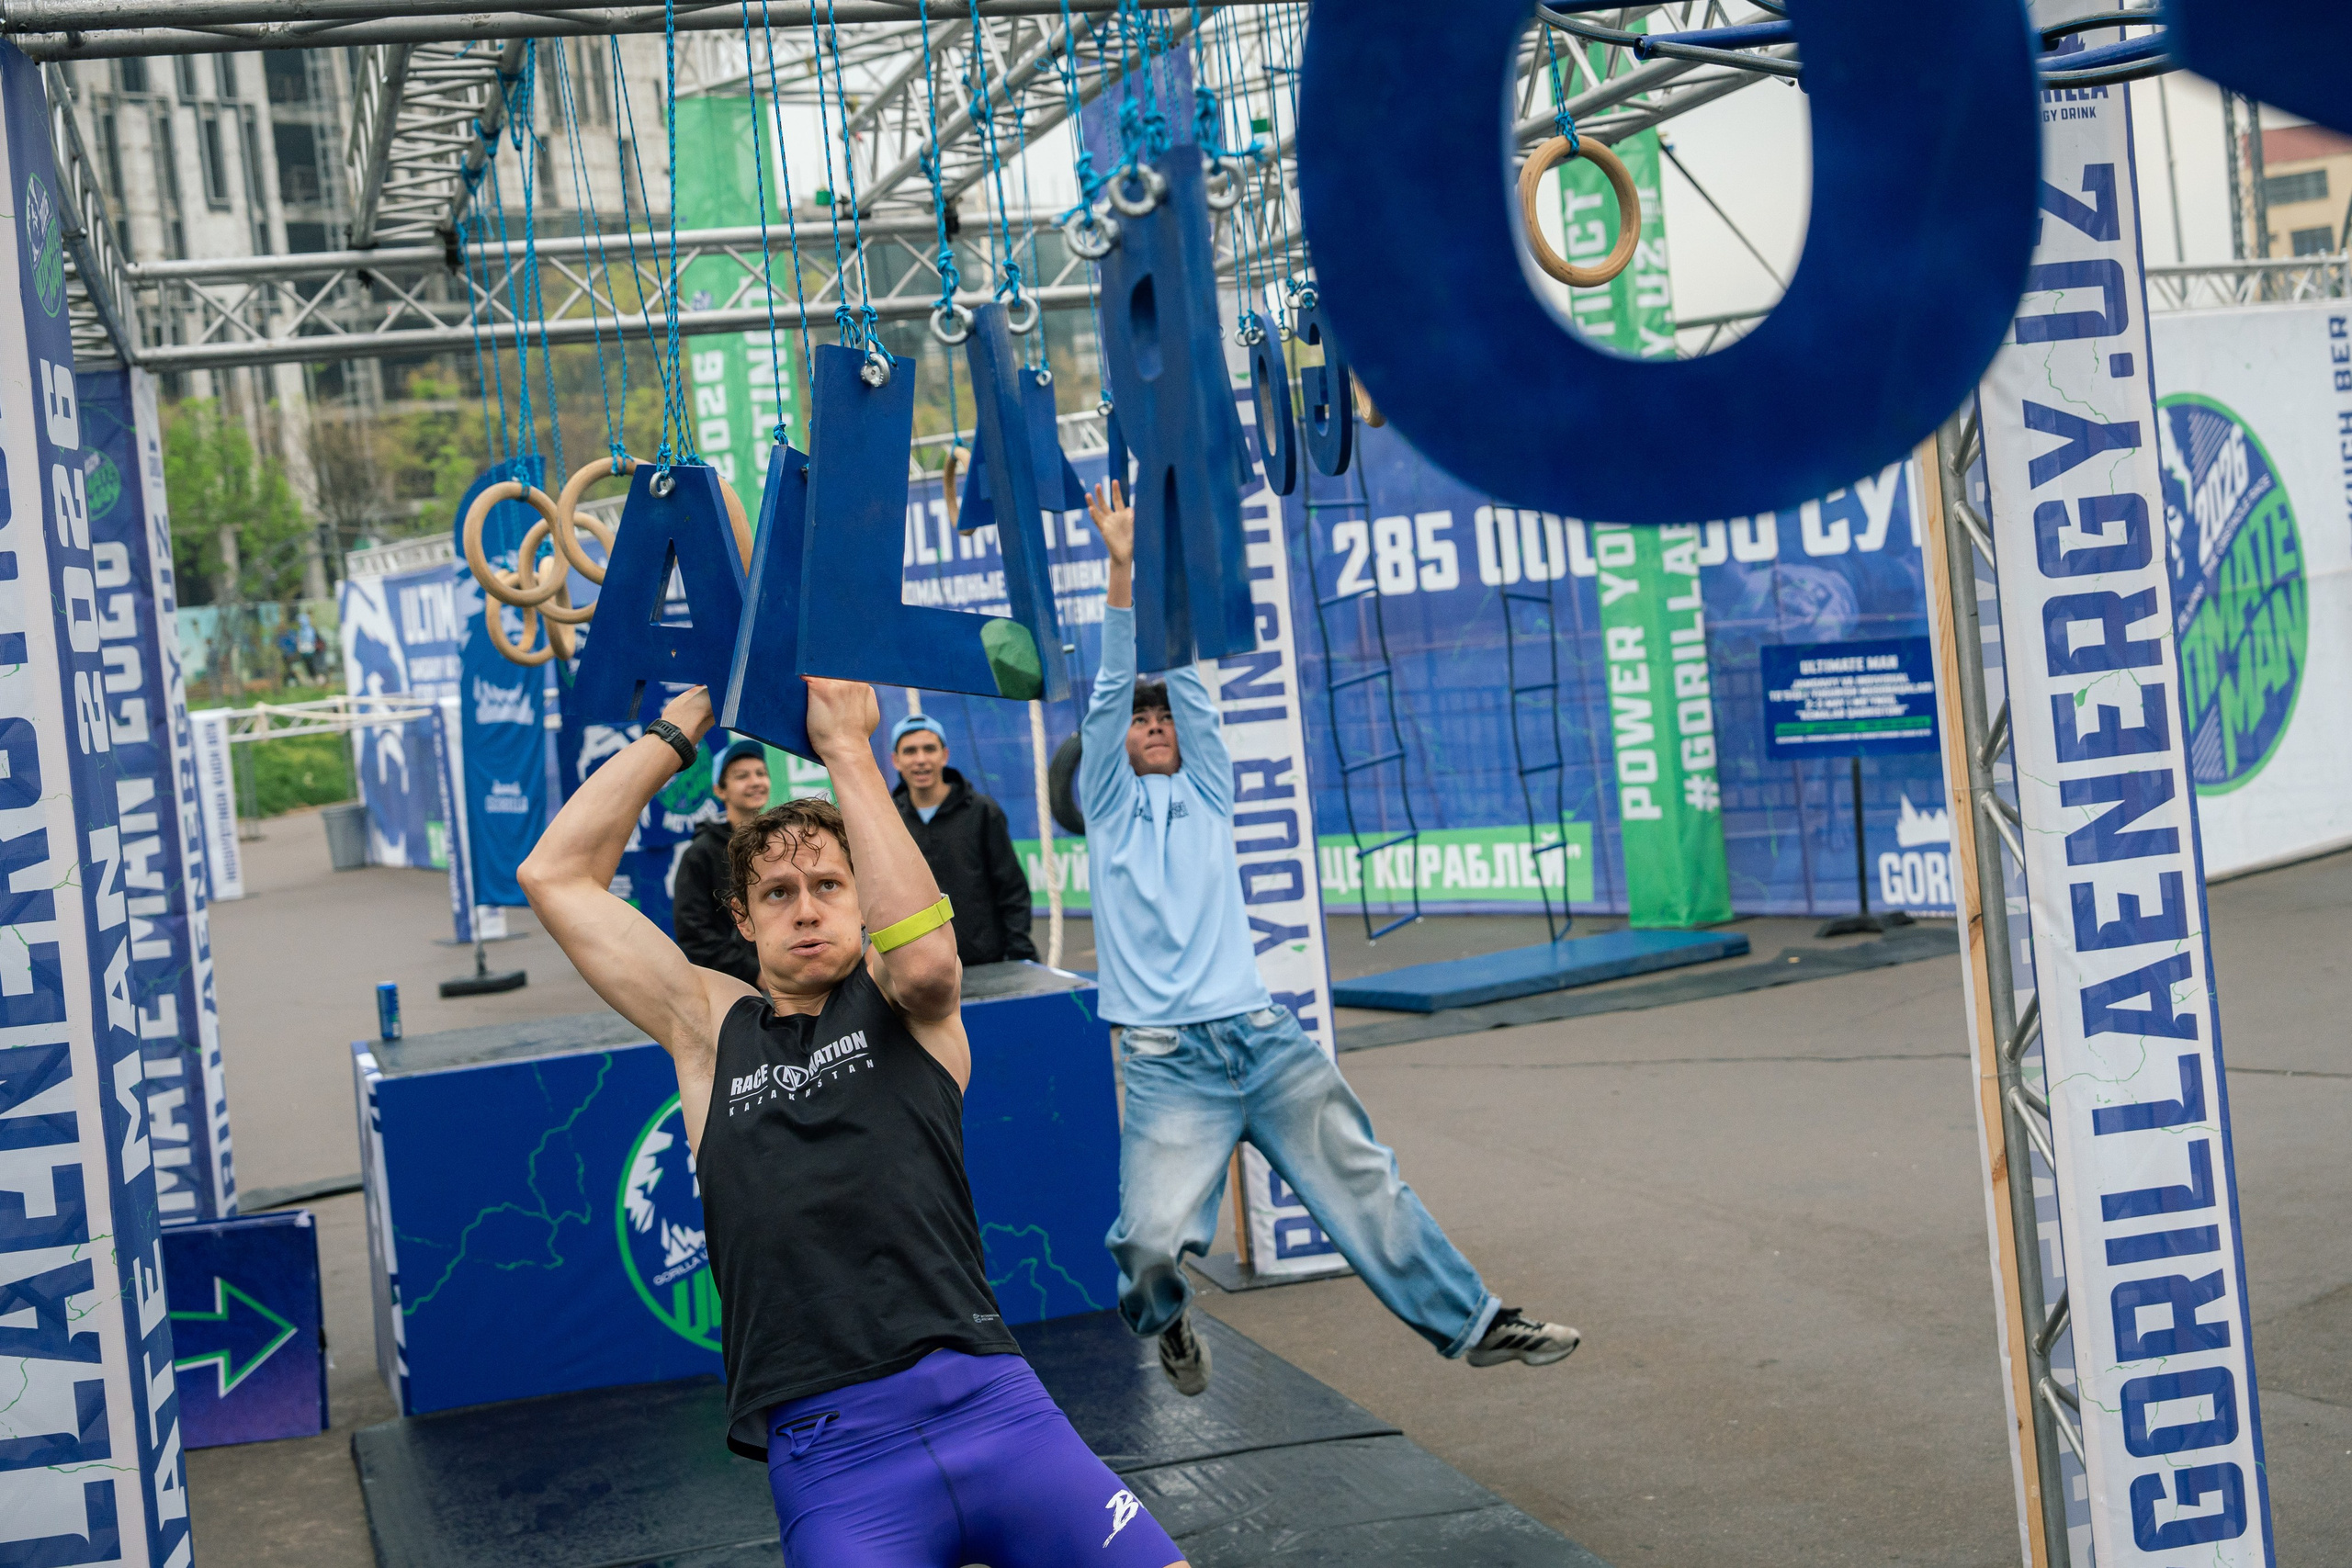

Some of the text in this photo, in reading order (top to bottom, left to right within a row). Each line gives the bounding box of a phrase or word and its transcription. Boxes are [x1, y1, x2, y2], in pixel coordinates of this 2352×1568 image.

[2061, 107, 2097, 120] DRINK
[40, 358, 110, 755] 2026
[1331, 509, 1459, 597] 285
[1595, 522, 1640, 606] YO
[2194, 423, 2249, 568] 2026
[1606, 626, 1663, 820] POWER
[1233, 756, 1310, 956] YOUR
[2015, 163, 2248, 1552] GORILLAENERGY.UZ
[89, 826, 152, 1185] MAN
[730, 1030, 868, 1097] RACE NATION
[729, 1058, 875, 1117] KAZAKHSTAN
